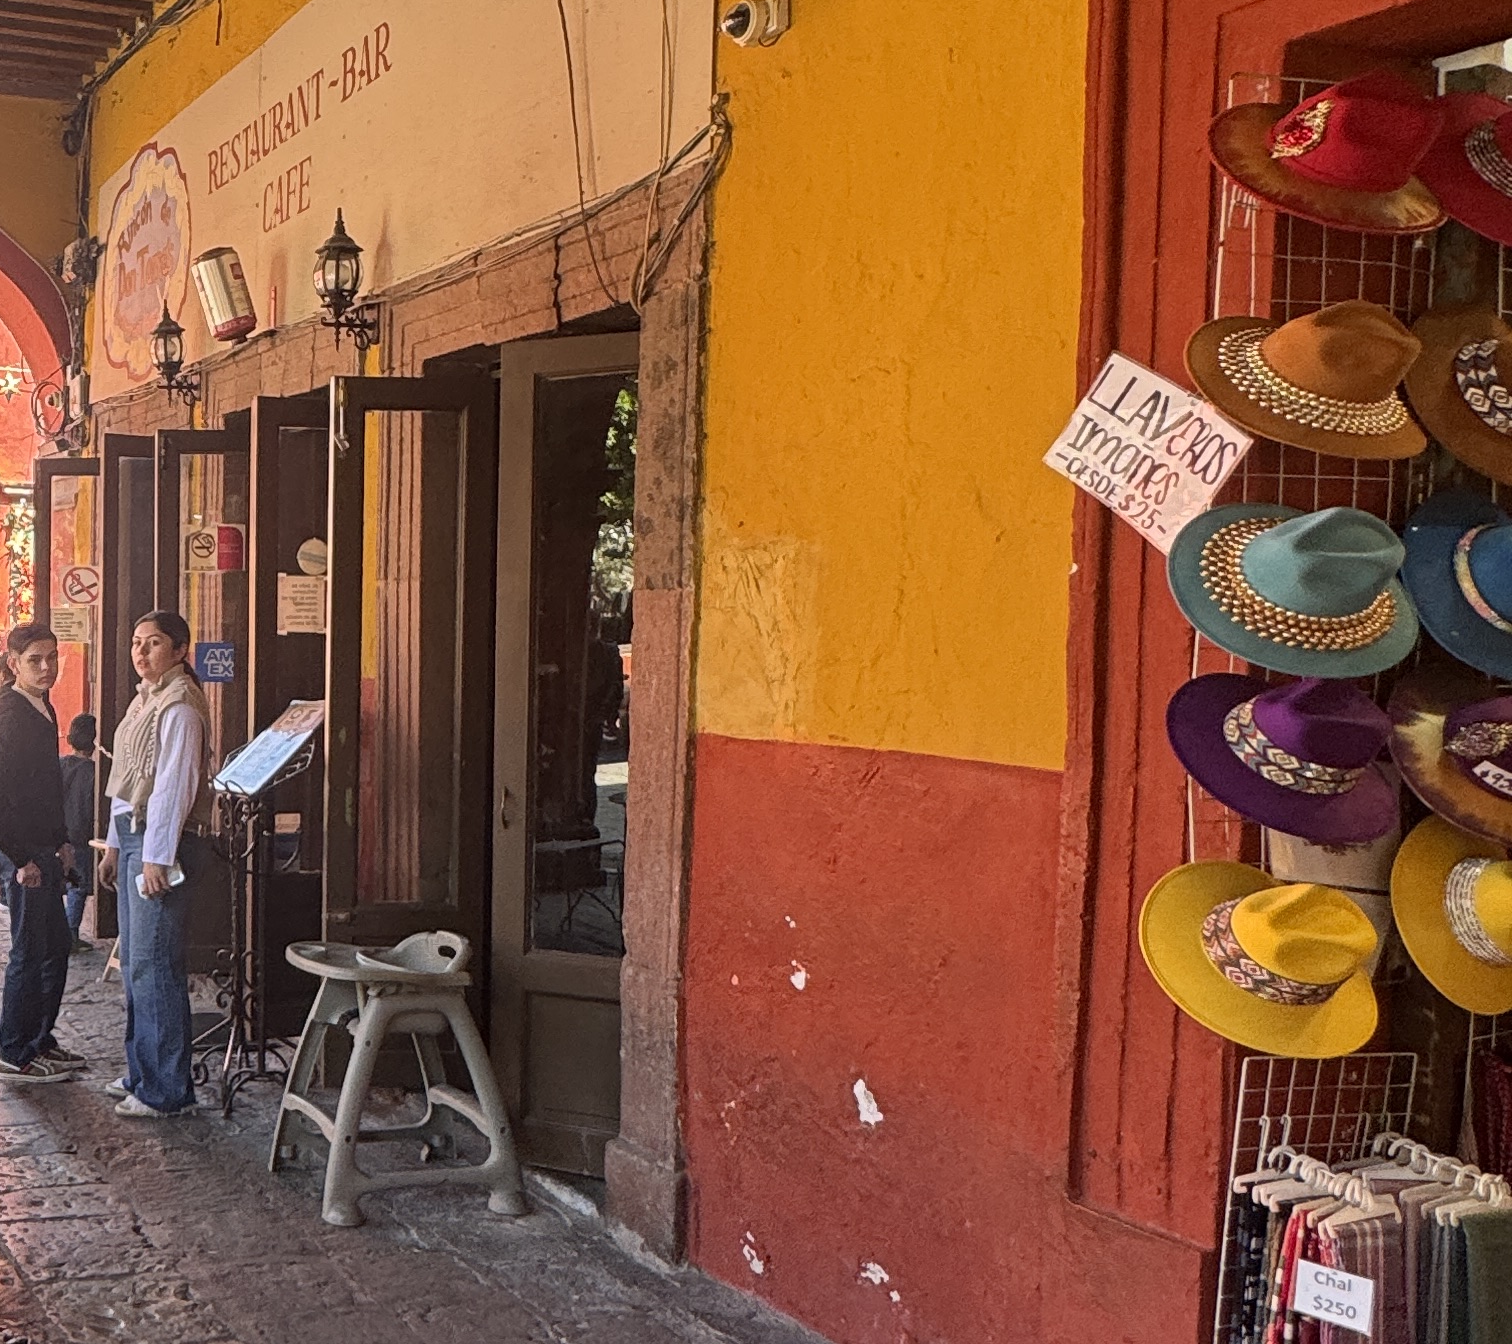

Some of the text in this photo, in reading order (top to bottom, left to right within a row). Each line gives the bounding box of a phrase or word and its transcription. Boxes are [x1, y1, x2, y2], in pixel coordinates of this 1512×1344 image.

[262, 155, 312, 233] CAFE
[1087, 363, 1238, 485] LLAVEROS
[205, 649, 234, 662] AM
[207, 662, 234, 677] EX
[1314, 1271, 1352, 1292] Chal
[1313, 1295, 1357, 1319] $250
